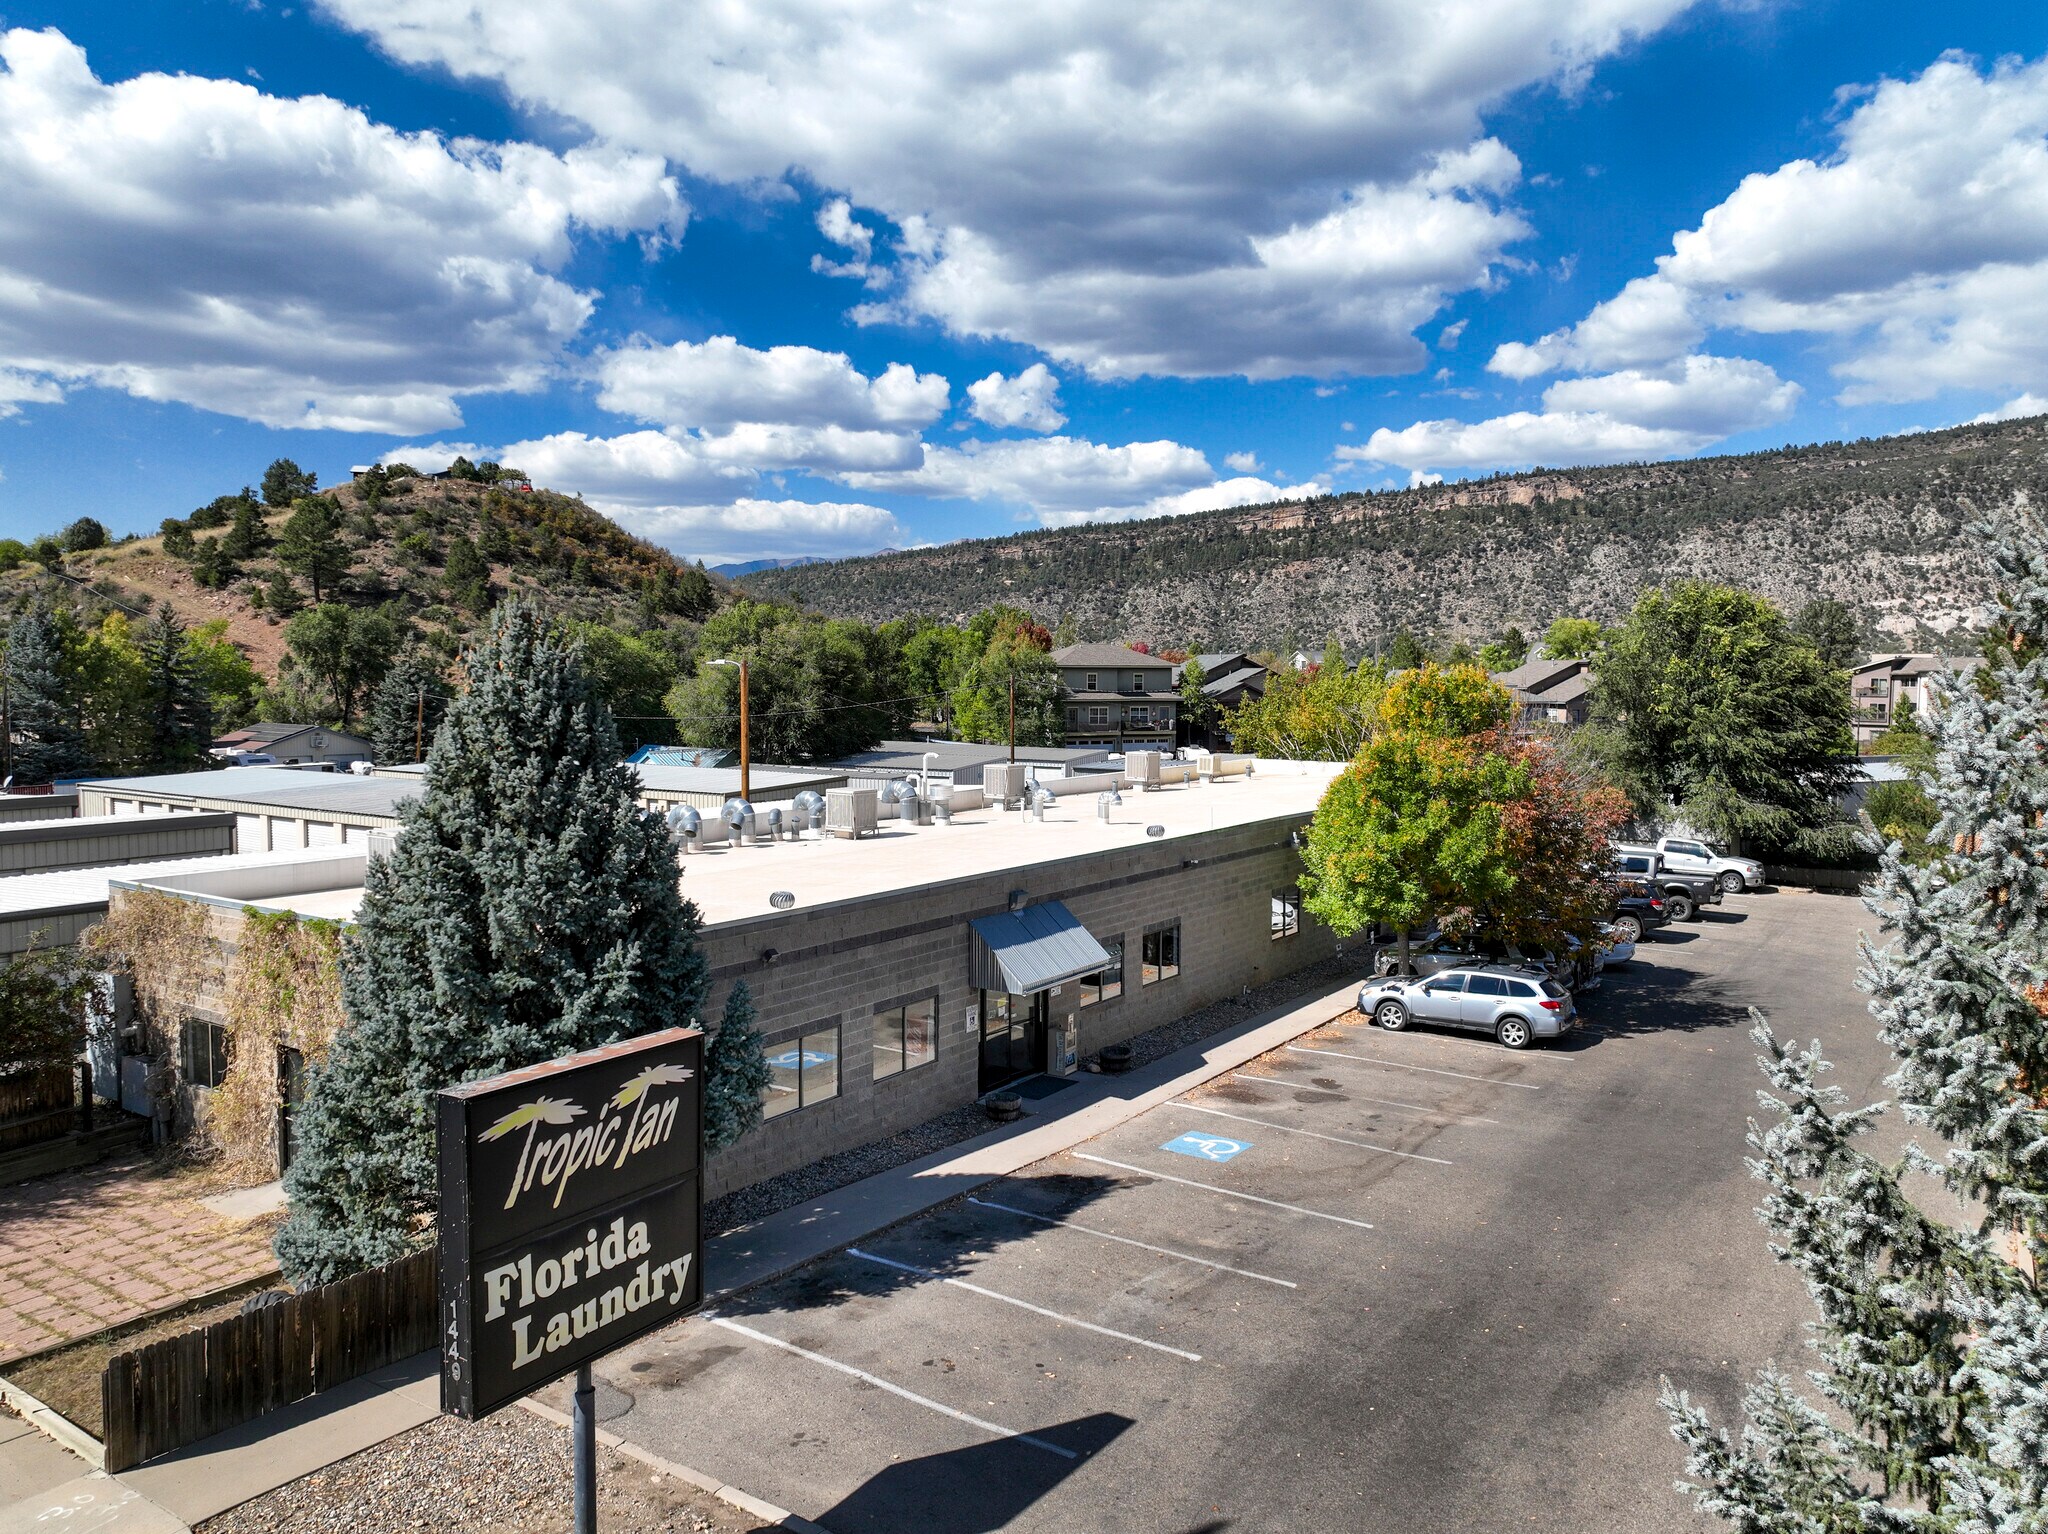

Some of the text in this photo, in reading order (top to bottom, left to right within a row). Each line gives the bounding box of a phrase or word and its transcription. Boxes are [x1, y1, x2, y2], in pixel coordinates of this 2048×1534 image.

[478, 1063, 694, 1210] Tropic Tan
[484, 1217, 652, 1322] Florida
[512, 1252, 692, 1371] Laundry
[447, 1300, 462, 1381] 1449
